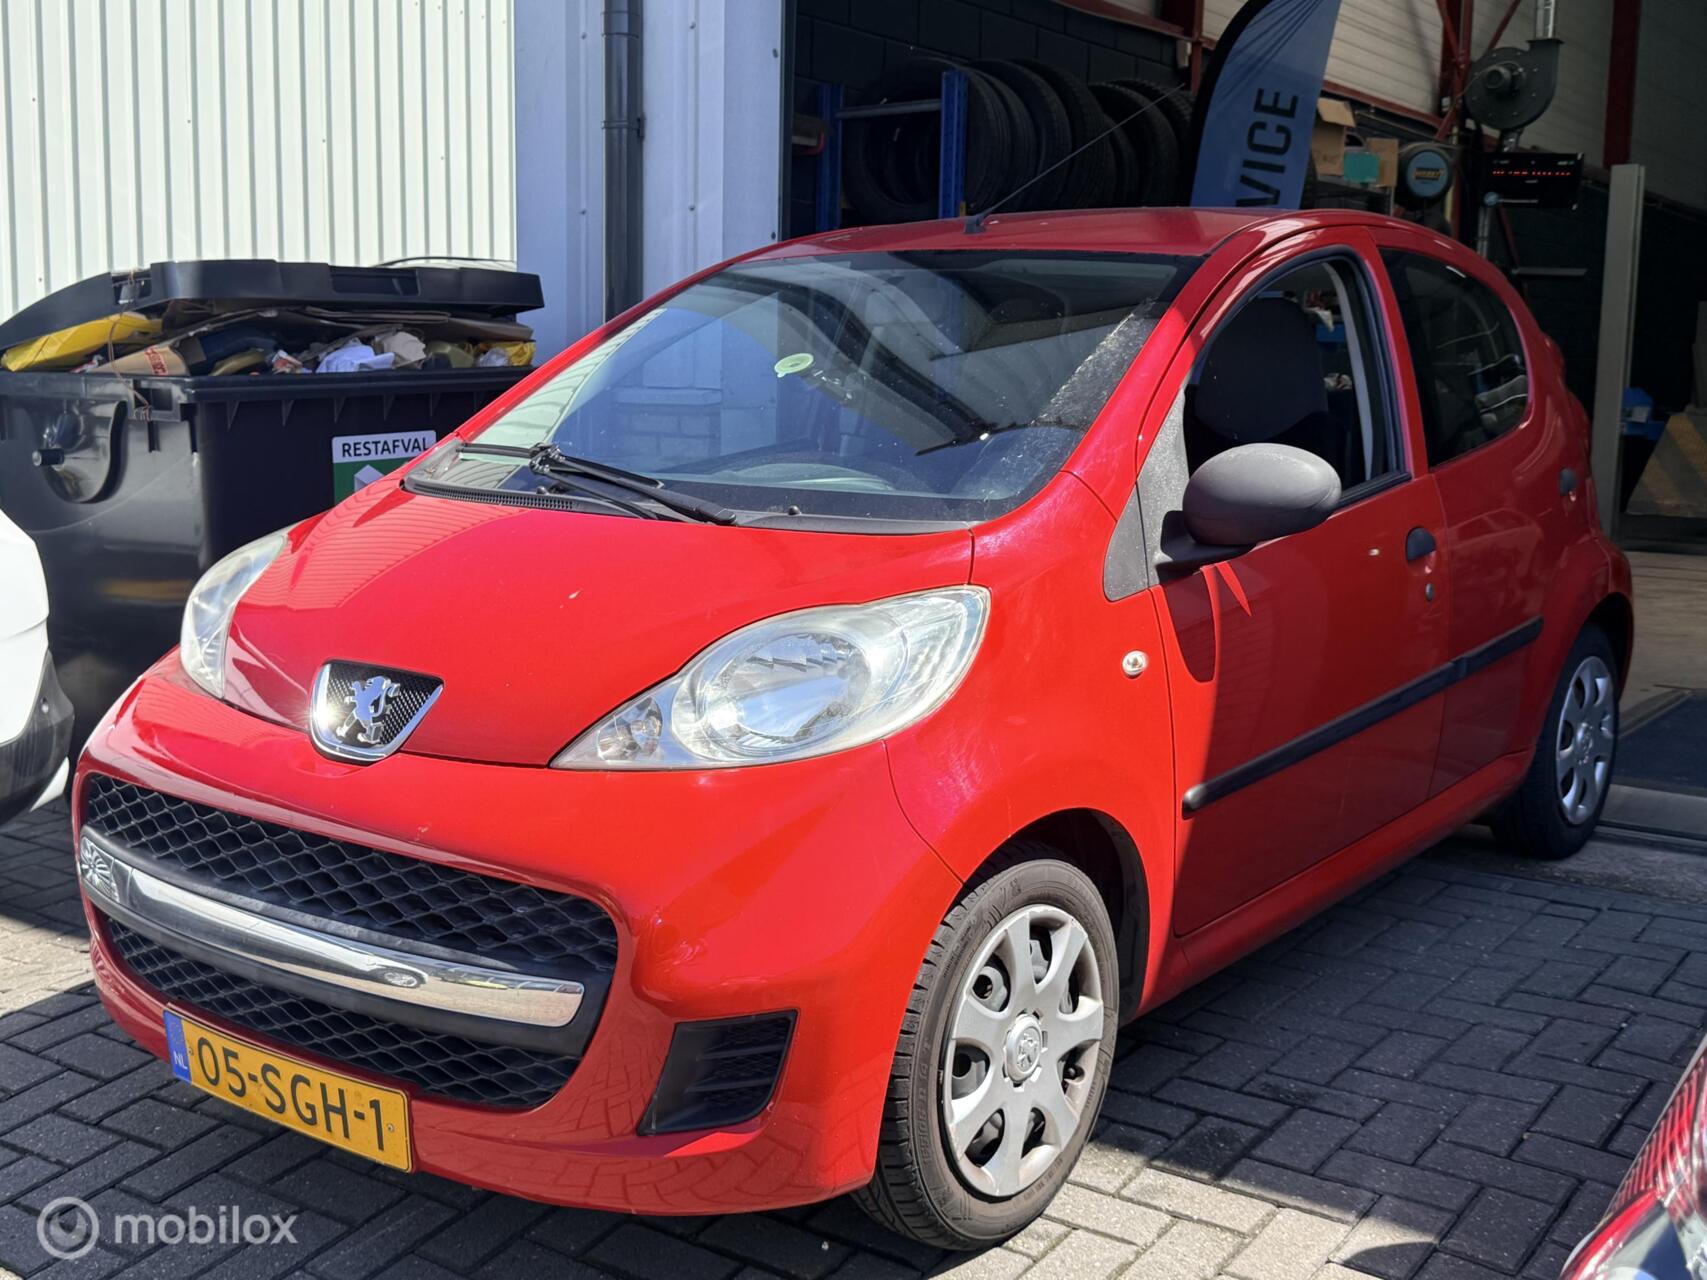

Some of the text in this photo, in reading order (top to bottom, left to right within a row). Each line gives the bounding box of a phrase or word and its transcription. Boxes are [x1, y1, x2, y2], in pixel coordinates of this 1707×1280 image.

[341, 437, 429, 458] RESTAFVAL
[173, 1050, 188, 1070] NL
[197, 1036, 385, 1152] 05-SGH-1
